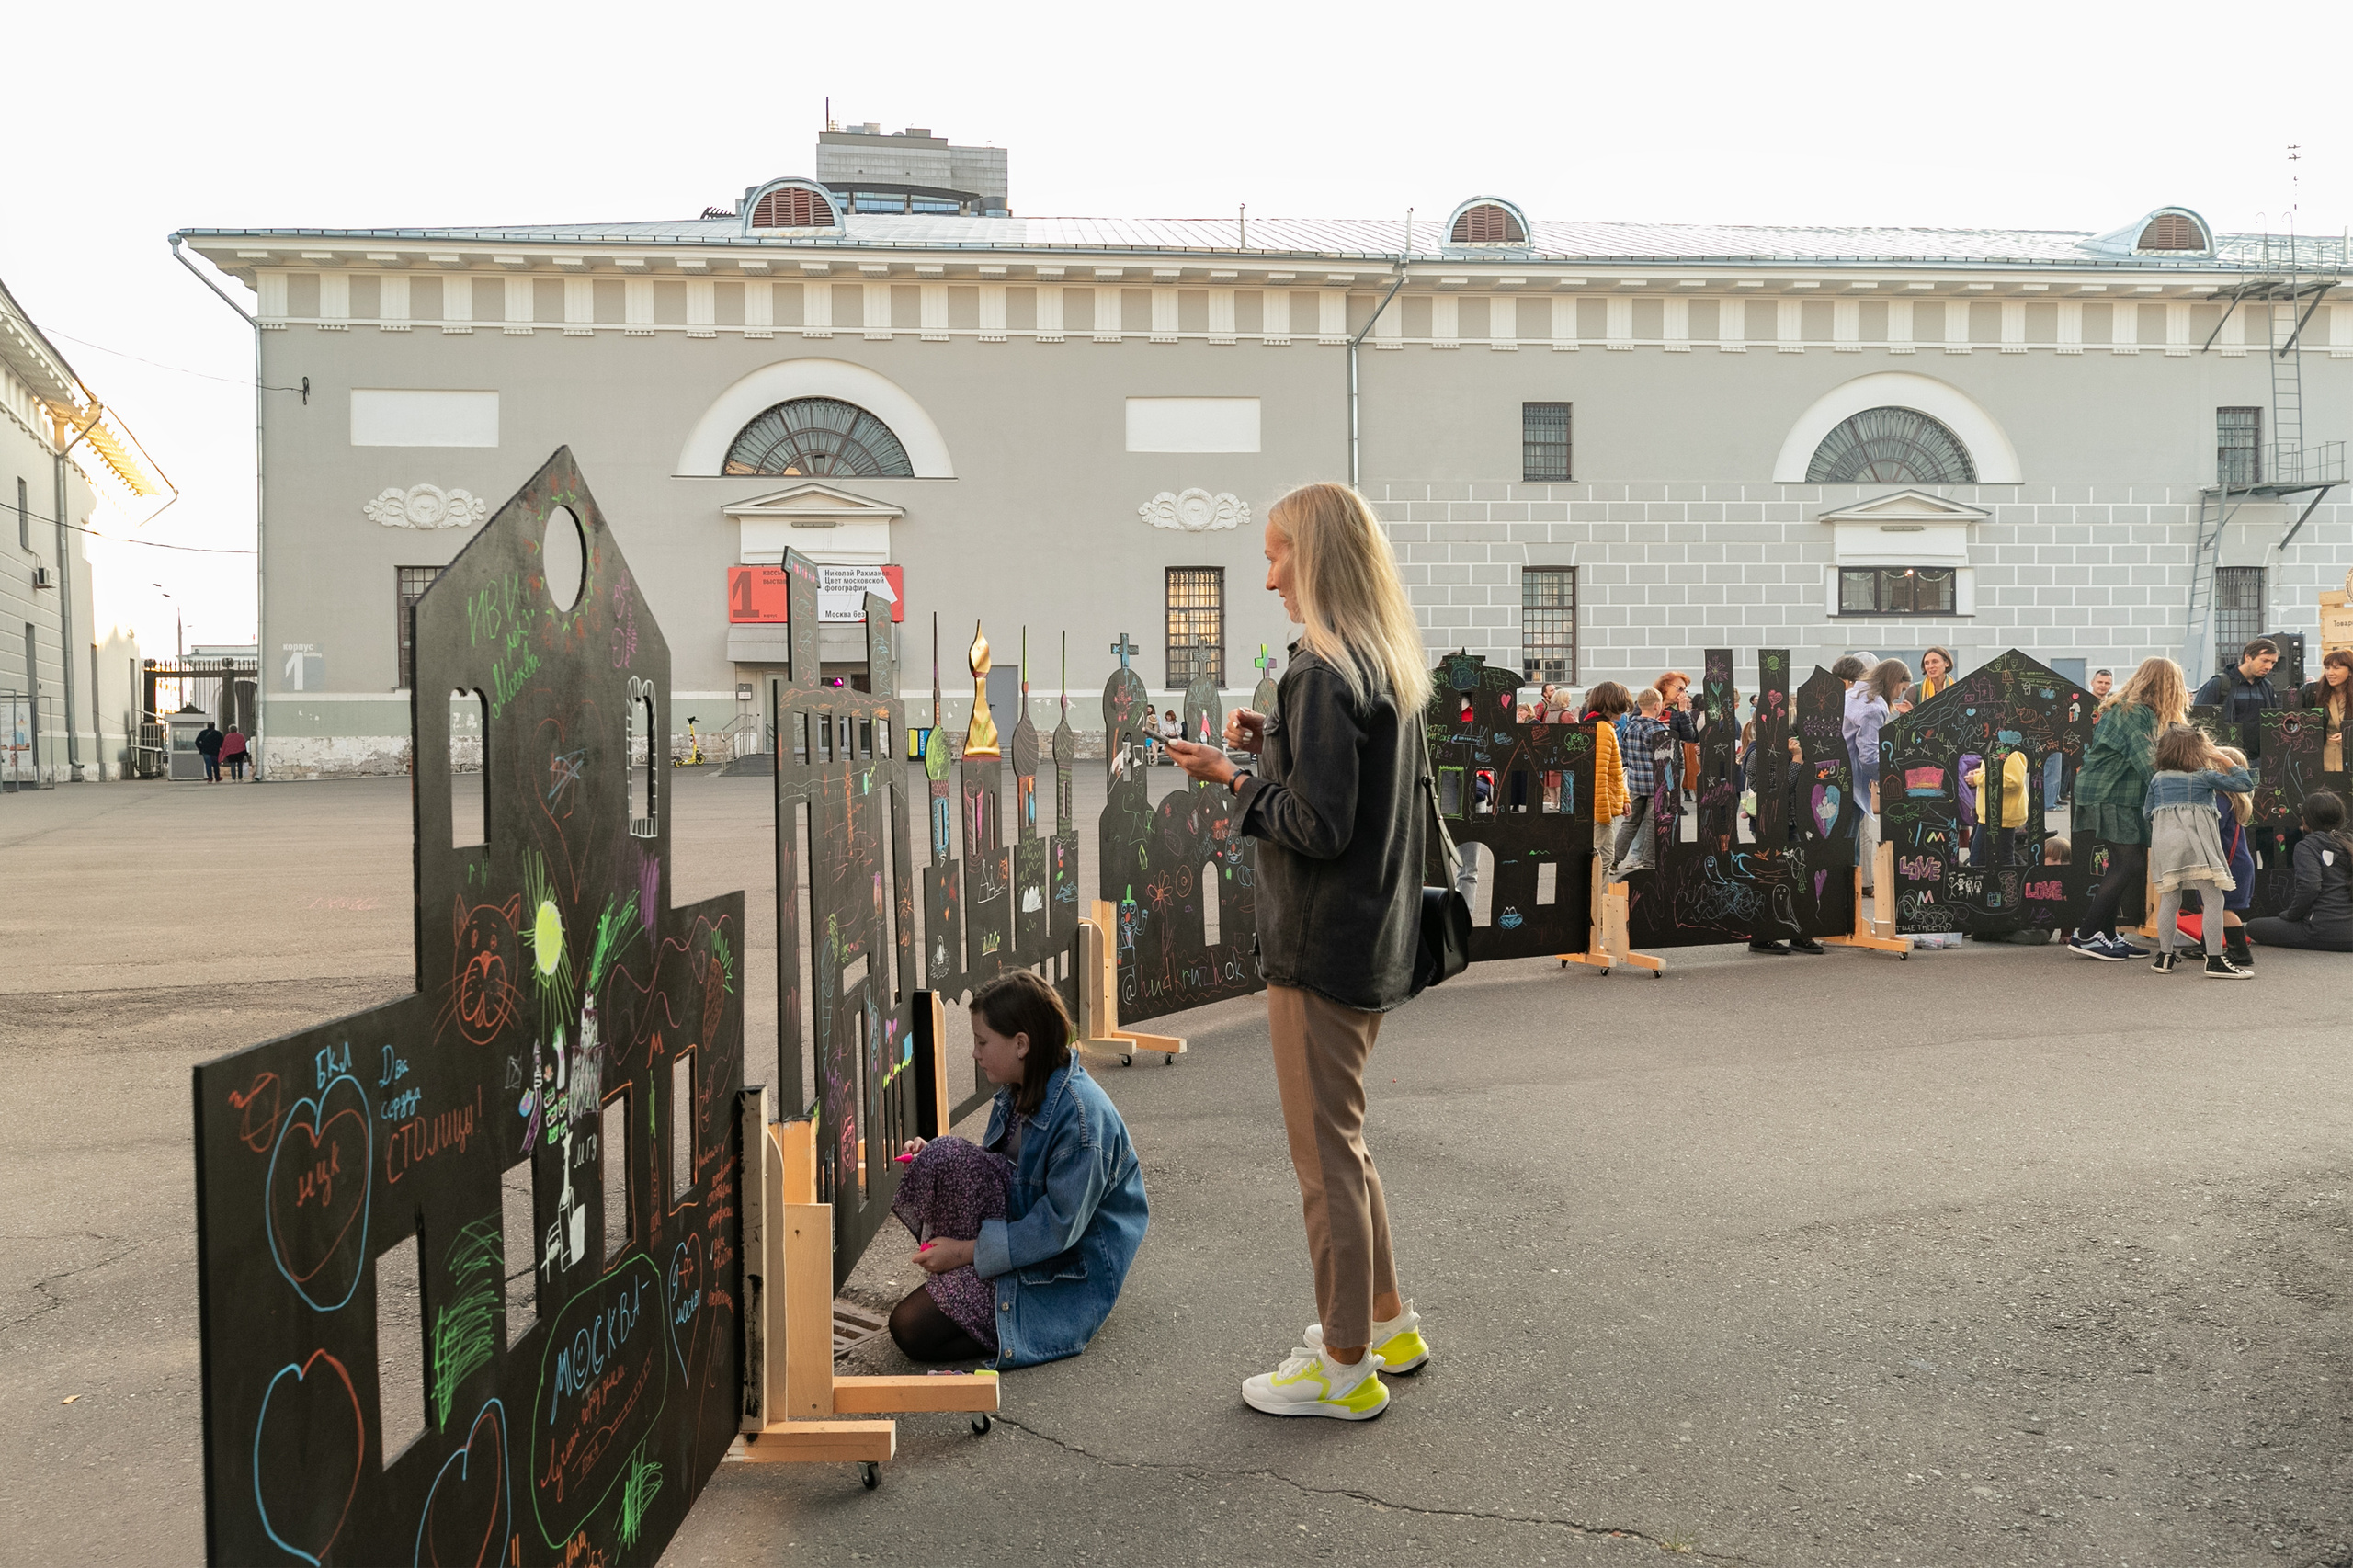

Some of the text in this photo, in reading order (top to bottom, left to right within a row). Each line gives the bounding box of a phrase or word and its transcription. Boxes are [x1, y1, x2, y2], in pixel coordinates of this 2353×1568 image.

[824, 569, 892, 577] Николай Рахманов.
[732, 570, 760, 618] 1
[824, 585, 868, 593] фотографии
[2334, 619, 2353, 628] Товар
[282, 643, 314, 653] корпус
[285, 652, 303, 690] 1
[1986, 754, 2000, 844] ПРИВЕТ
[1899, 855, 1942, 881] LOVE
